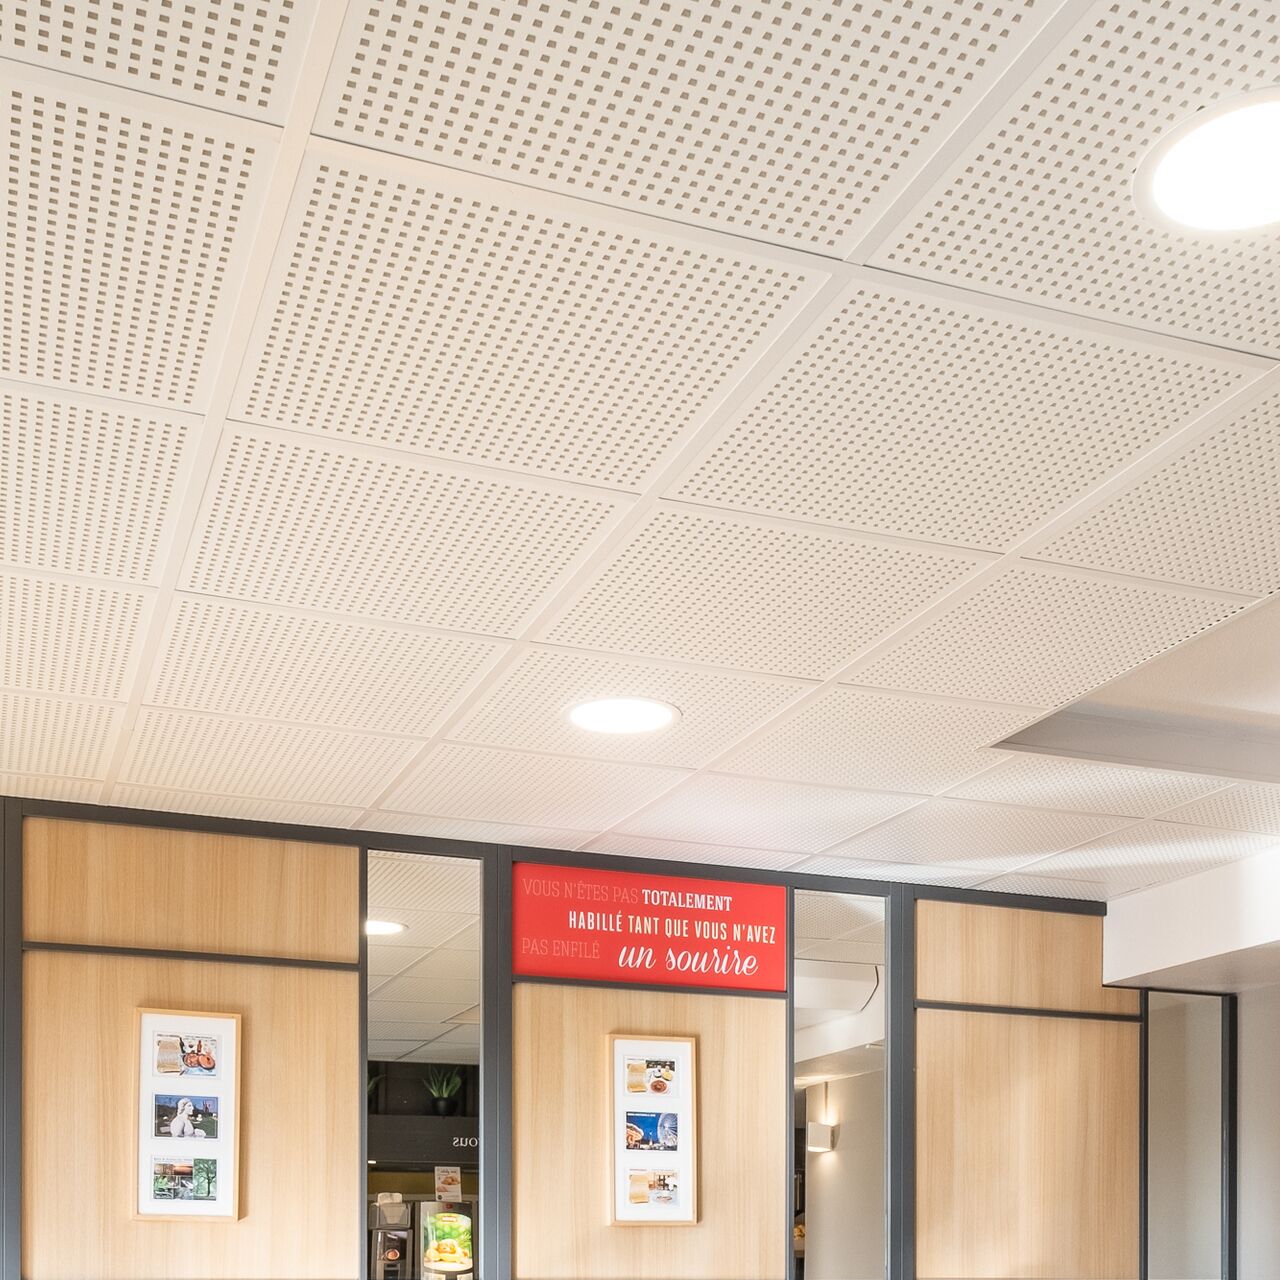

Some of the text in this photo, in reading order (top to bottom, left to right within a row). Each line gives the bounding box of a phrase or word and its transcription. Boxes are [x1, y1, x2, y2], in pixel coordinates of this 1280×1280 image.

[522, 878, 560, 898] VOUS
[613, 886, 639, 905] PAS
[642, 889, 733, 911] TOTALEMENT
[569, 910, 776, 944] HABILLÉ TANT QUE VOUS N'AVEZ
[521, 937, 759, 976] PAS ENFILÉ un sourire
